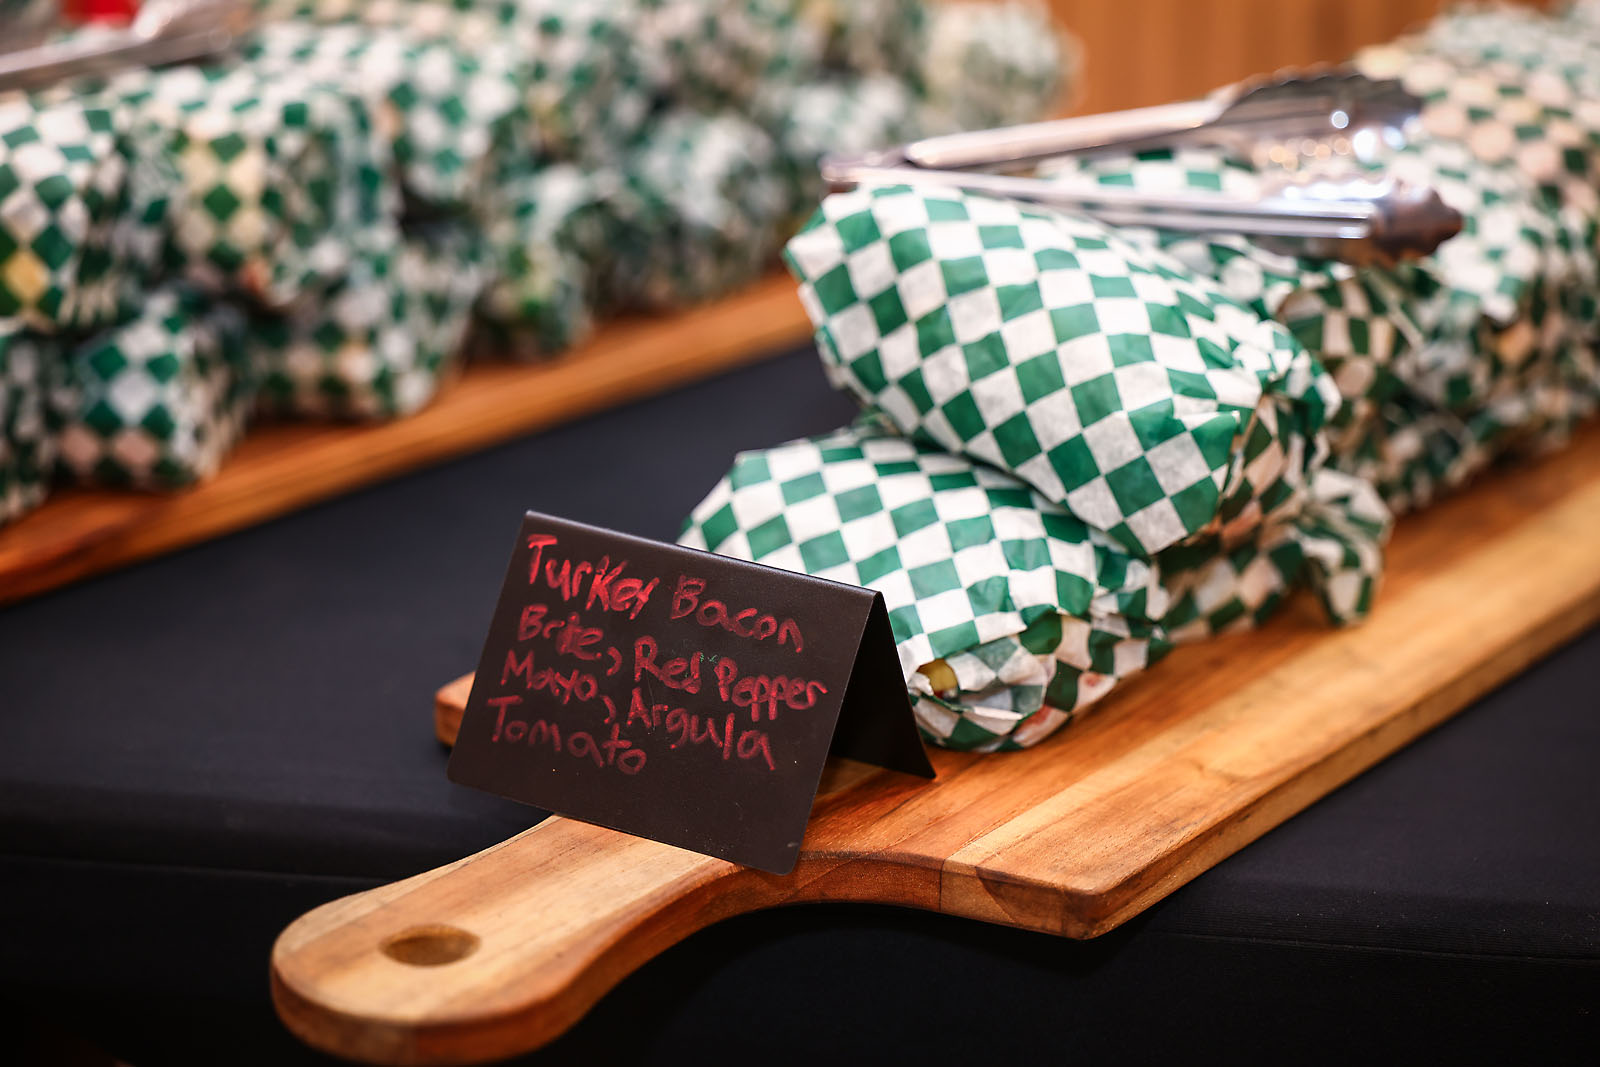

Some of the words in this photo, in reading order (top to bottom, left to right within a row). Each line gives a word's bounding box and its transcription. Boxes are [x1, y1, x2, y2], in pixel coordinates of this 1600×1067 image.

[527, 534, 660, 620] Turkey
[671, 575, 804, 653] Bacon
[627, 687, 776, 771] Argula
[714, 657, 828, 722] Pepper
[487, 696, 647, 775] Tomato
